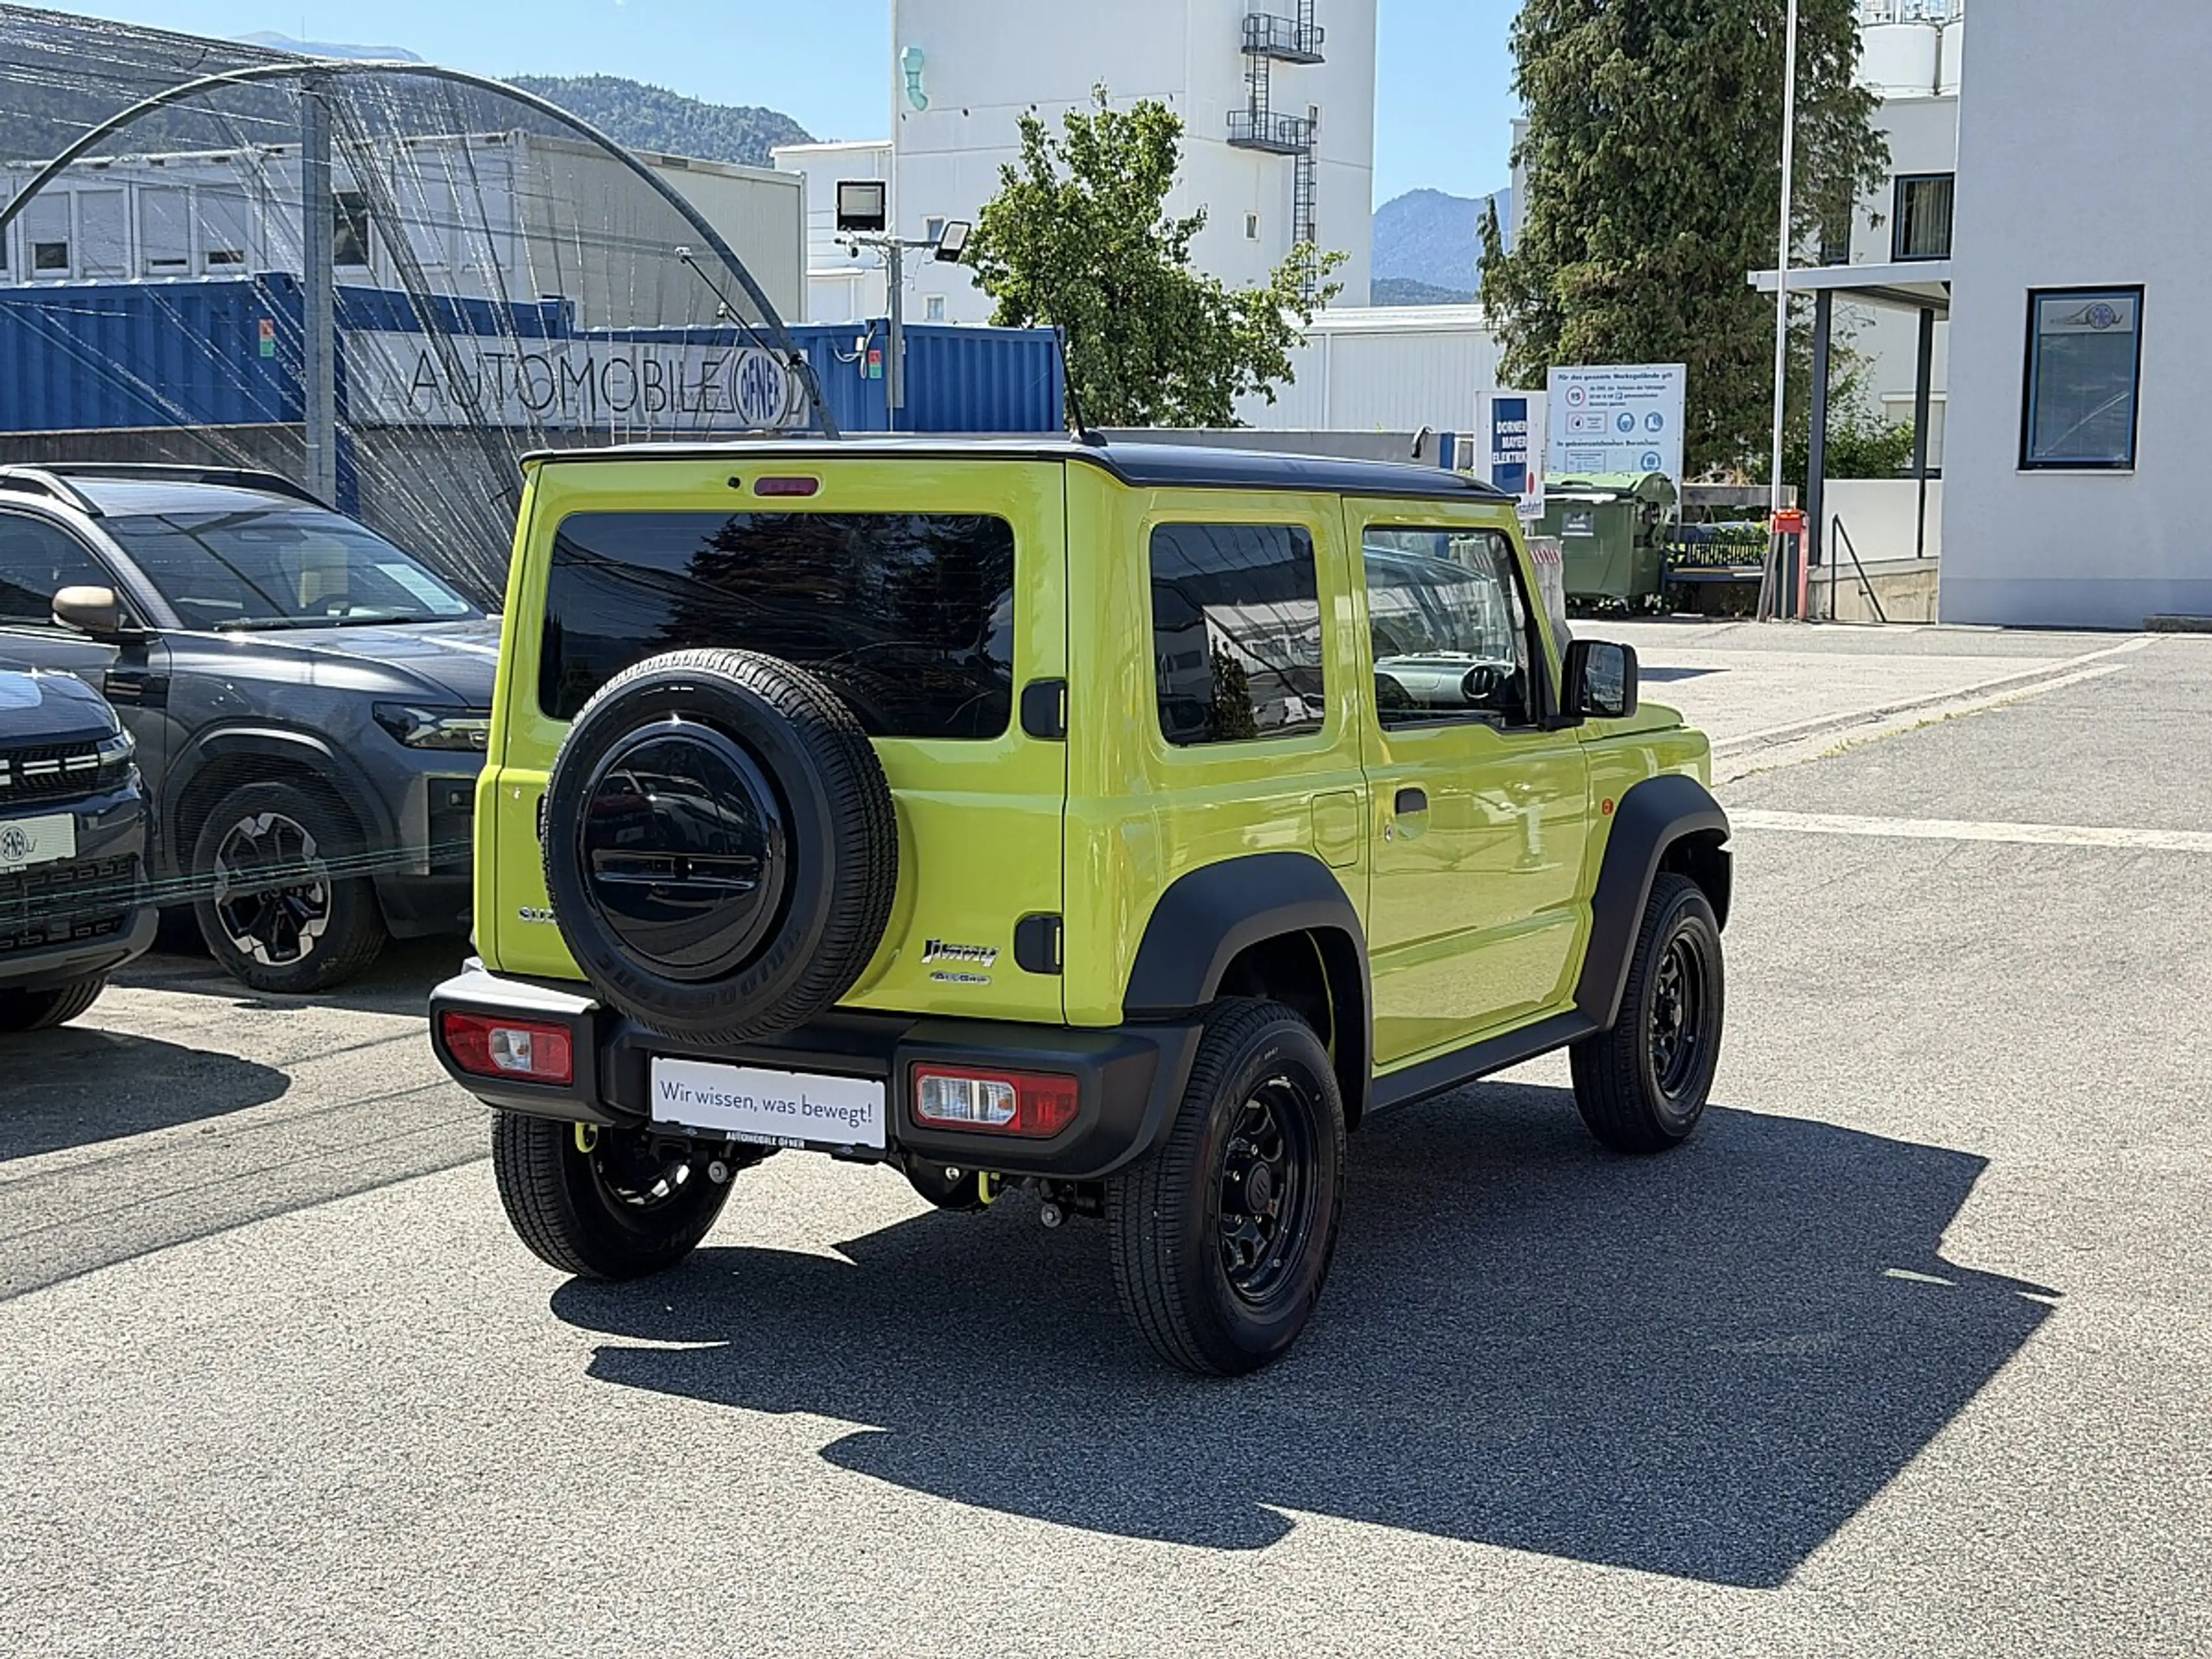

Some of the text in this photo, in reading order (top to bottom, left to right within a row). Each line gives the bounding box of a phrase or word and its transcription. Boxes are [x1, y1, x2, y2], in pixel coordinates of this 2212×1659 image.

[406, 349, 720, 412] AUTOMOBILE
[1571, 392, 1581, 400] 15
[660, 1080, 873, 1128] Wir wissen, was bewegt!
[726, 1131, 777, 1146] AUTOMOBILE
